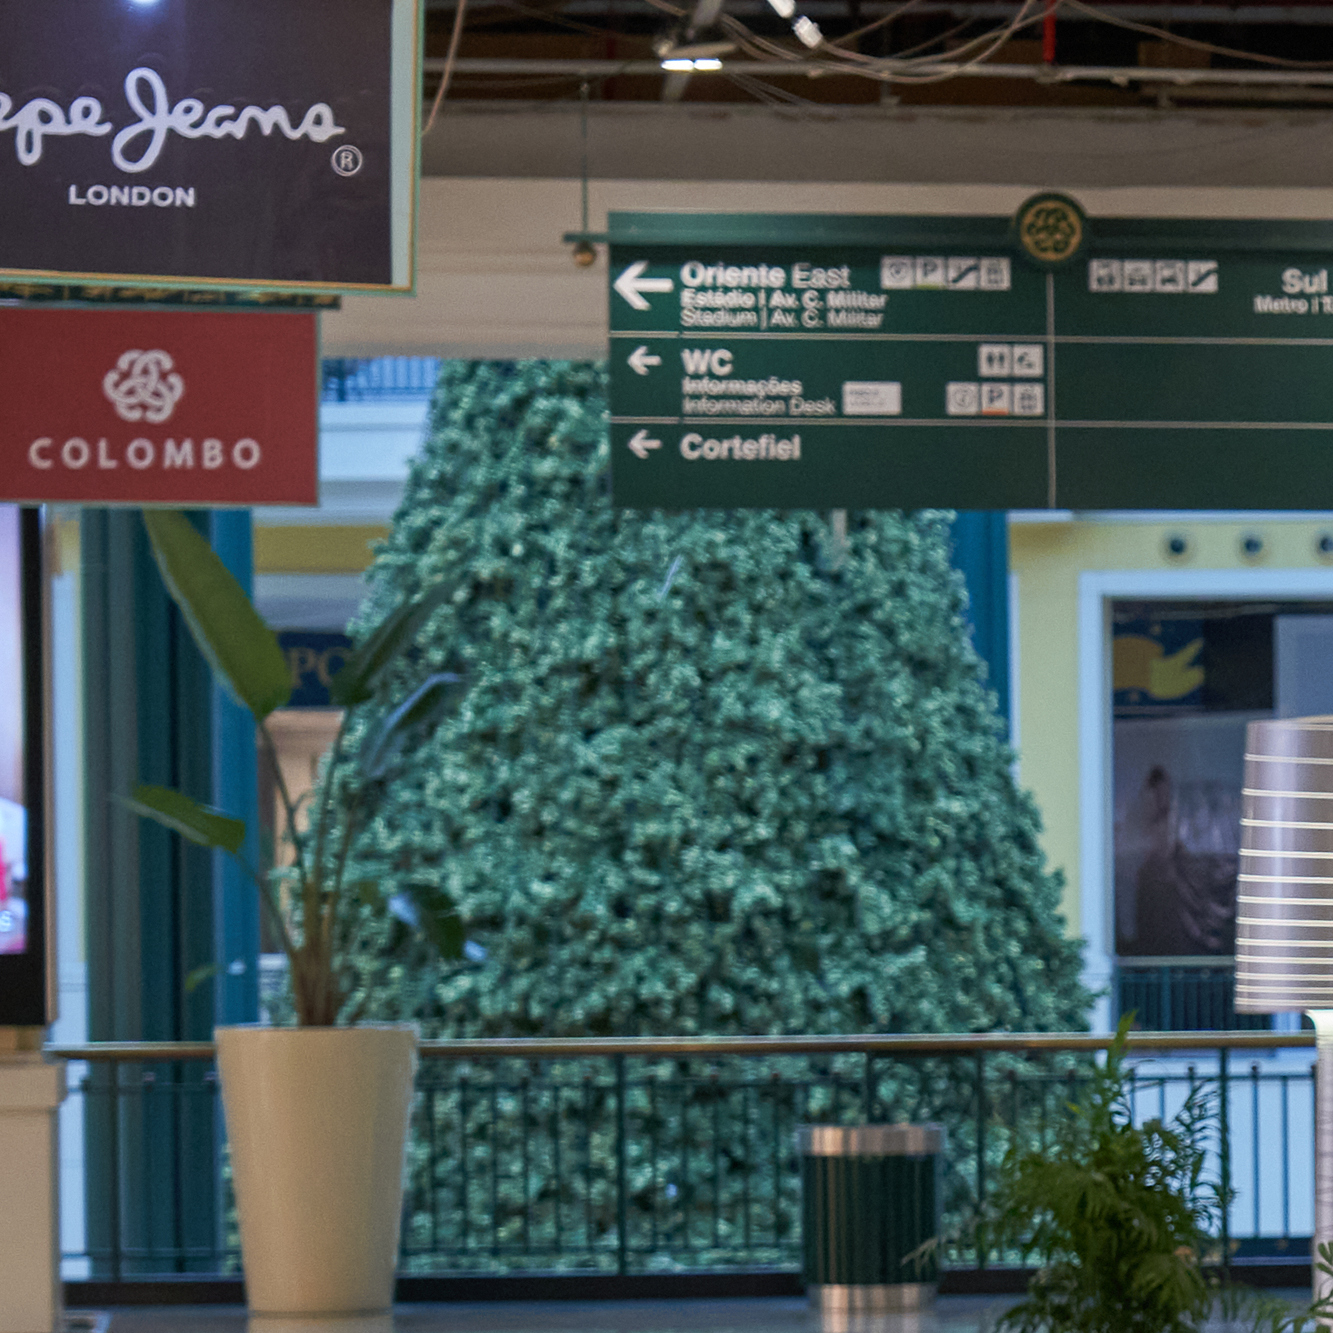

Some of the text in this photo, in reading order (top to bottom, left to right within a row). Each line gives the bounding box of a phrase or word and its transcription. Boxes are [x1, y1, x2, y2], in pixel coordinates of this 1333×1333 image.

[112, 67, 345, 172] Jeans
[69, 184, 195, 207] LONDON
[681, 261, 850, 288] Oriente East
[1282, 268, 1328, 294] Sul
[769, 290, 799, 308] Av.
[802, 290, 824, 308] C.
[1254, 295, 1308, 314] Metro
[681, 307, 757, 326] Stadium
[769, 309, 799, 327] Av.
[802, 309, 824, 328] C.
[681, 349, 733, 376] WC
[682, 376, 803, 397] Informações
[682, 397, 836, 415] Information Desk
[28, 437, 261, 469] COLOMBO
[680, 433, 801, 460] Cortefiel
